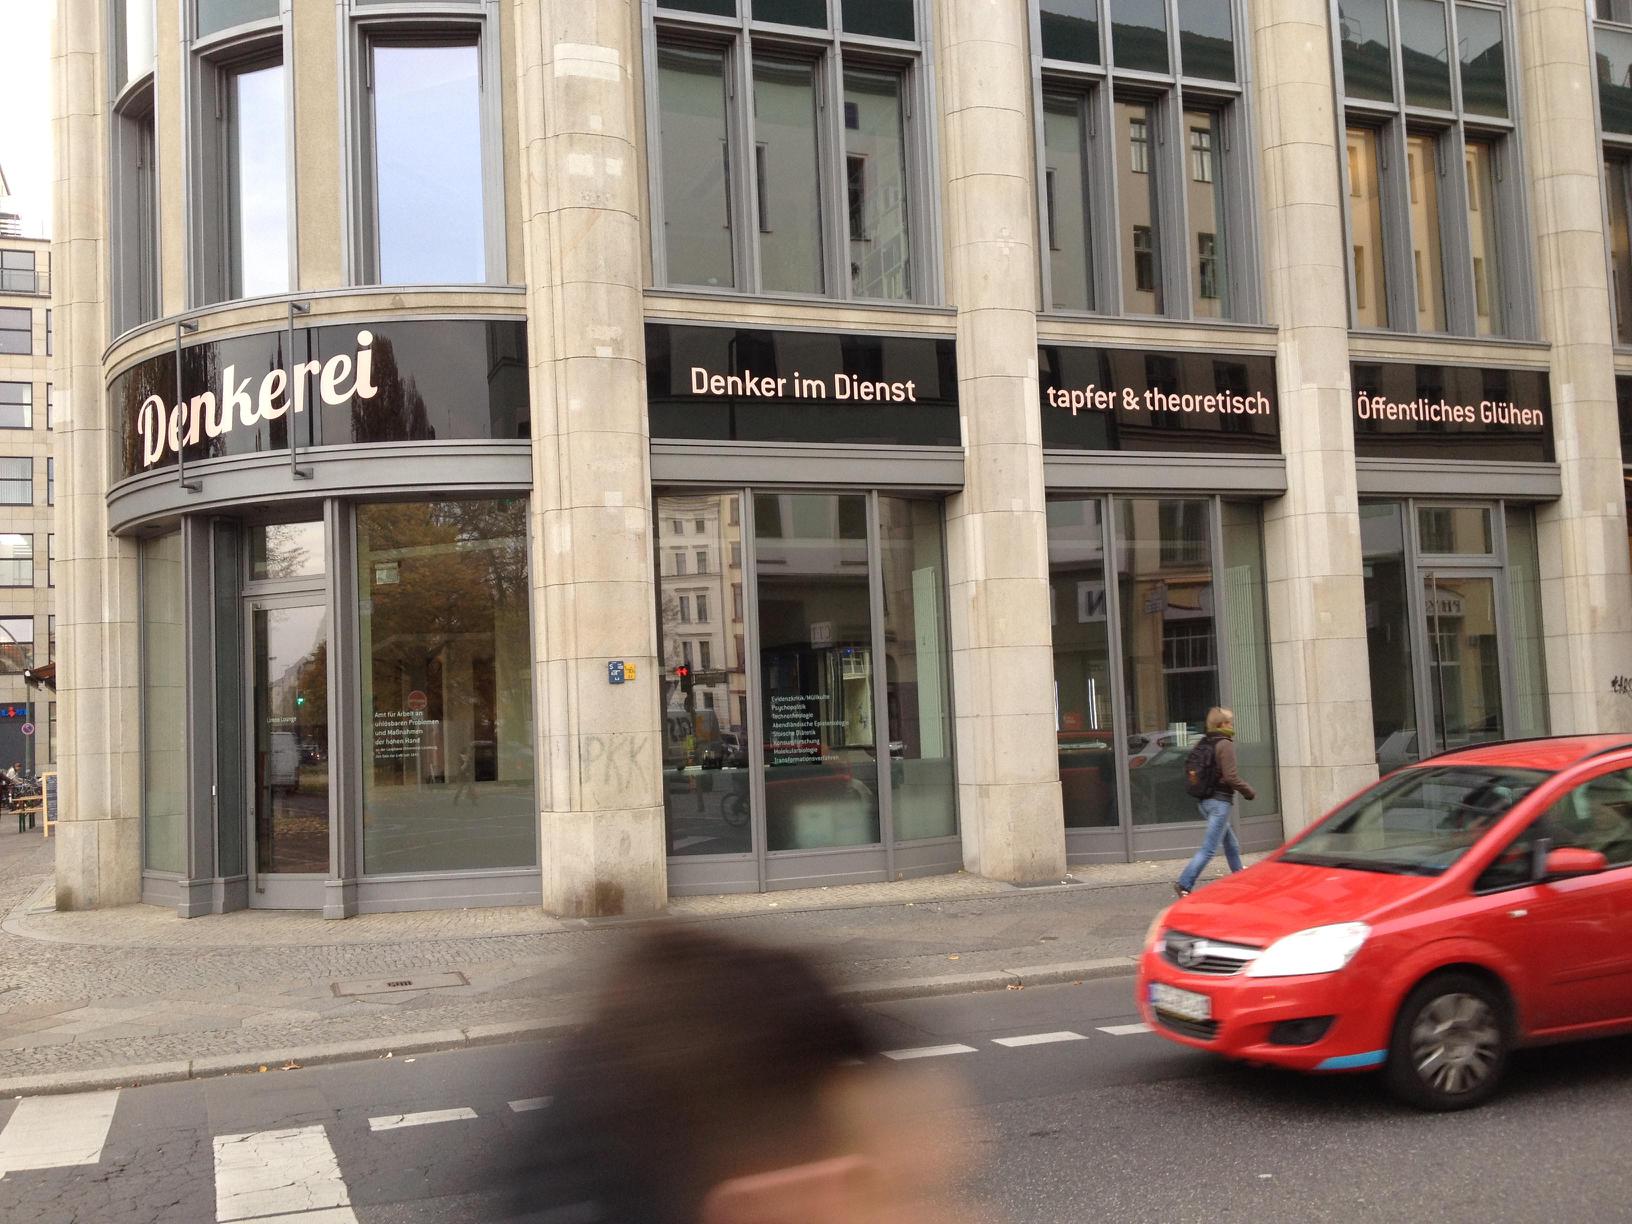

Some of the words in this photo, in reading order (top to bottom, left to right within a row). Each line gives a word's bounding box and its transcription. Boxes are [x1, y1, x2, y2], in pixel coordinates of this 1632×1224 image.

[137, 329, 378, 467] Denkerei
[691, 367, 787, 398] Denker
[794, 371, 826, 399] im
[834, 373, 916, 402] Dienst
[1046, 384, 1117, 416] tapfer
[1122, 387, 1140, 411] &
[1143, 386, 1270, 415] theoretisch
[1357, 390, 1475, 423] Öffentliches
[1480, 400, 1544, 426] Glühen
